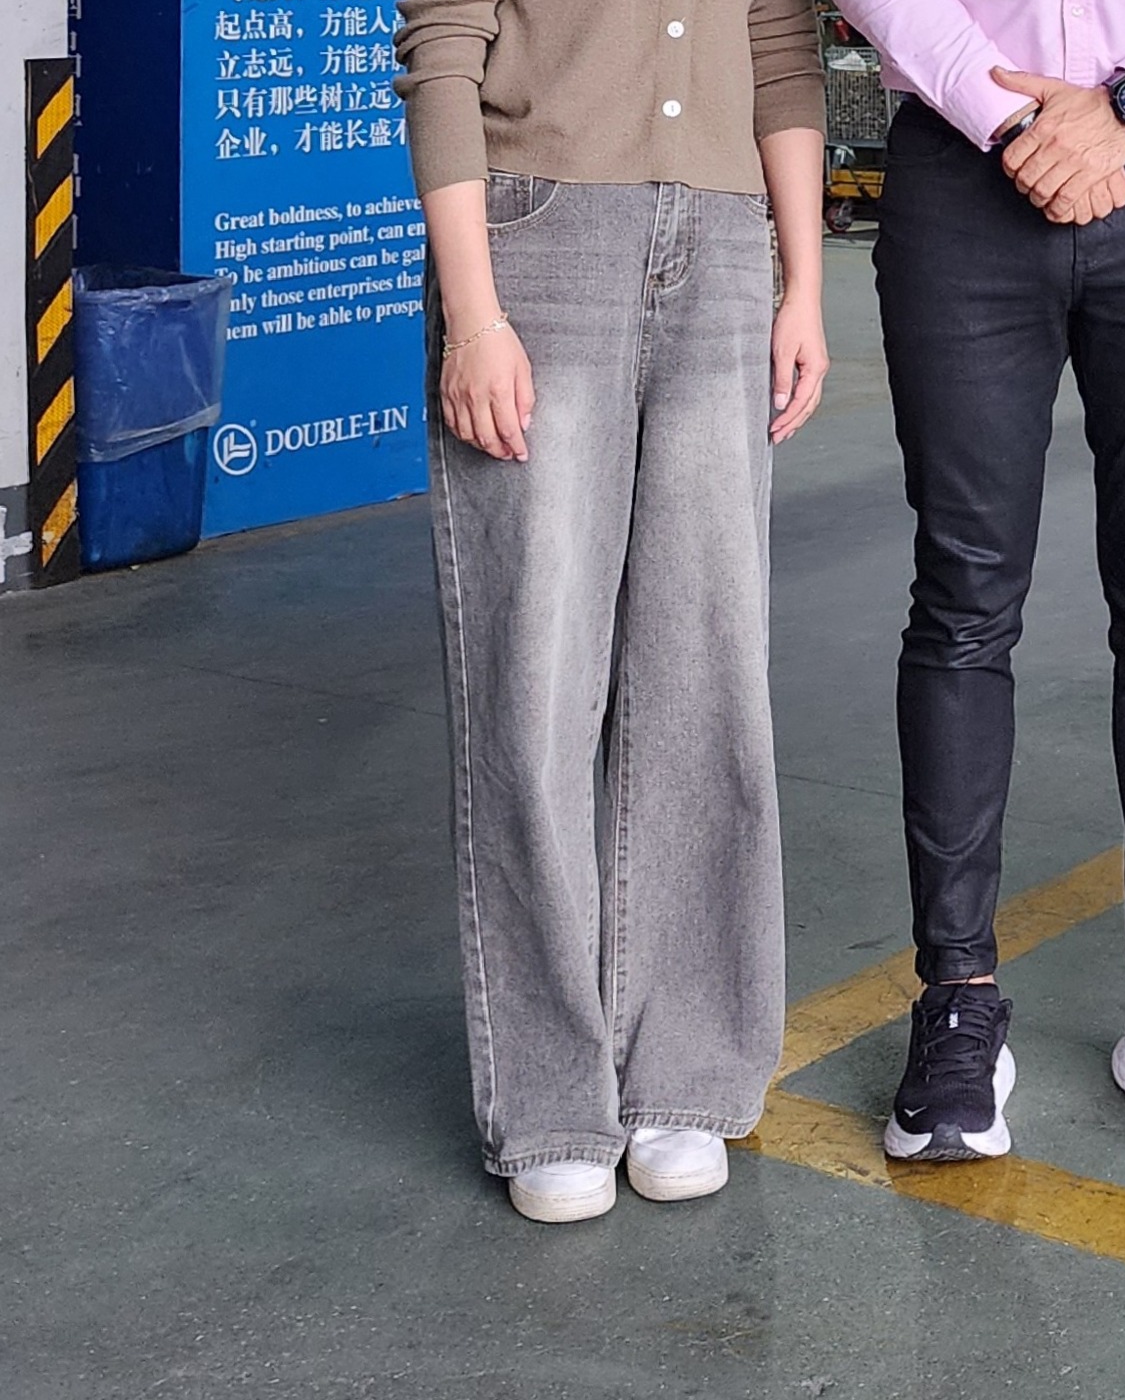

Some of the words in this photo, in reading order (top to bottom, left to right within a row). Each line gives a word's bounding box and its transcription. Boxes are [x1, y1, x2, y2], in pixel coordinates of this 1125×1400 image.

[214, 80, 405, 120] 只有那些树立远
[214, 209, 265, 232] Great
[268, 205, 343, 227] boldness,
[346, 201, 362, 218] to
[365, 195, 422, 216] achieve
[214, 238, 257, 262] High
[261, 231, 325, 253] starting
[329, 225, 374, 250] point,
[377, 225, 404, 241] can
[243, 265, 263, 284] be
[266, 256, 347, 281] ambitious
[350, 253, 378, 269] can
[381, 248, 399, 265] be
[230, 293, 257, 314] nly
[261, 287, 303, 309] those
[307, 276, 394, 302] enterprises
[262, 313, 292, 335] will
[297, 311, 315, 330] be
[318, 305, 352, 327] able
[356, 306, 372, 321] to
[264, 405, 409, 456] DOUBLE-LIN
